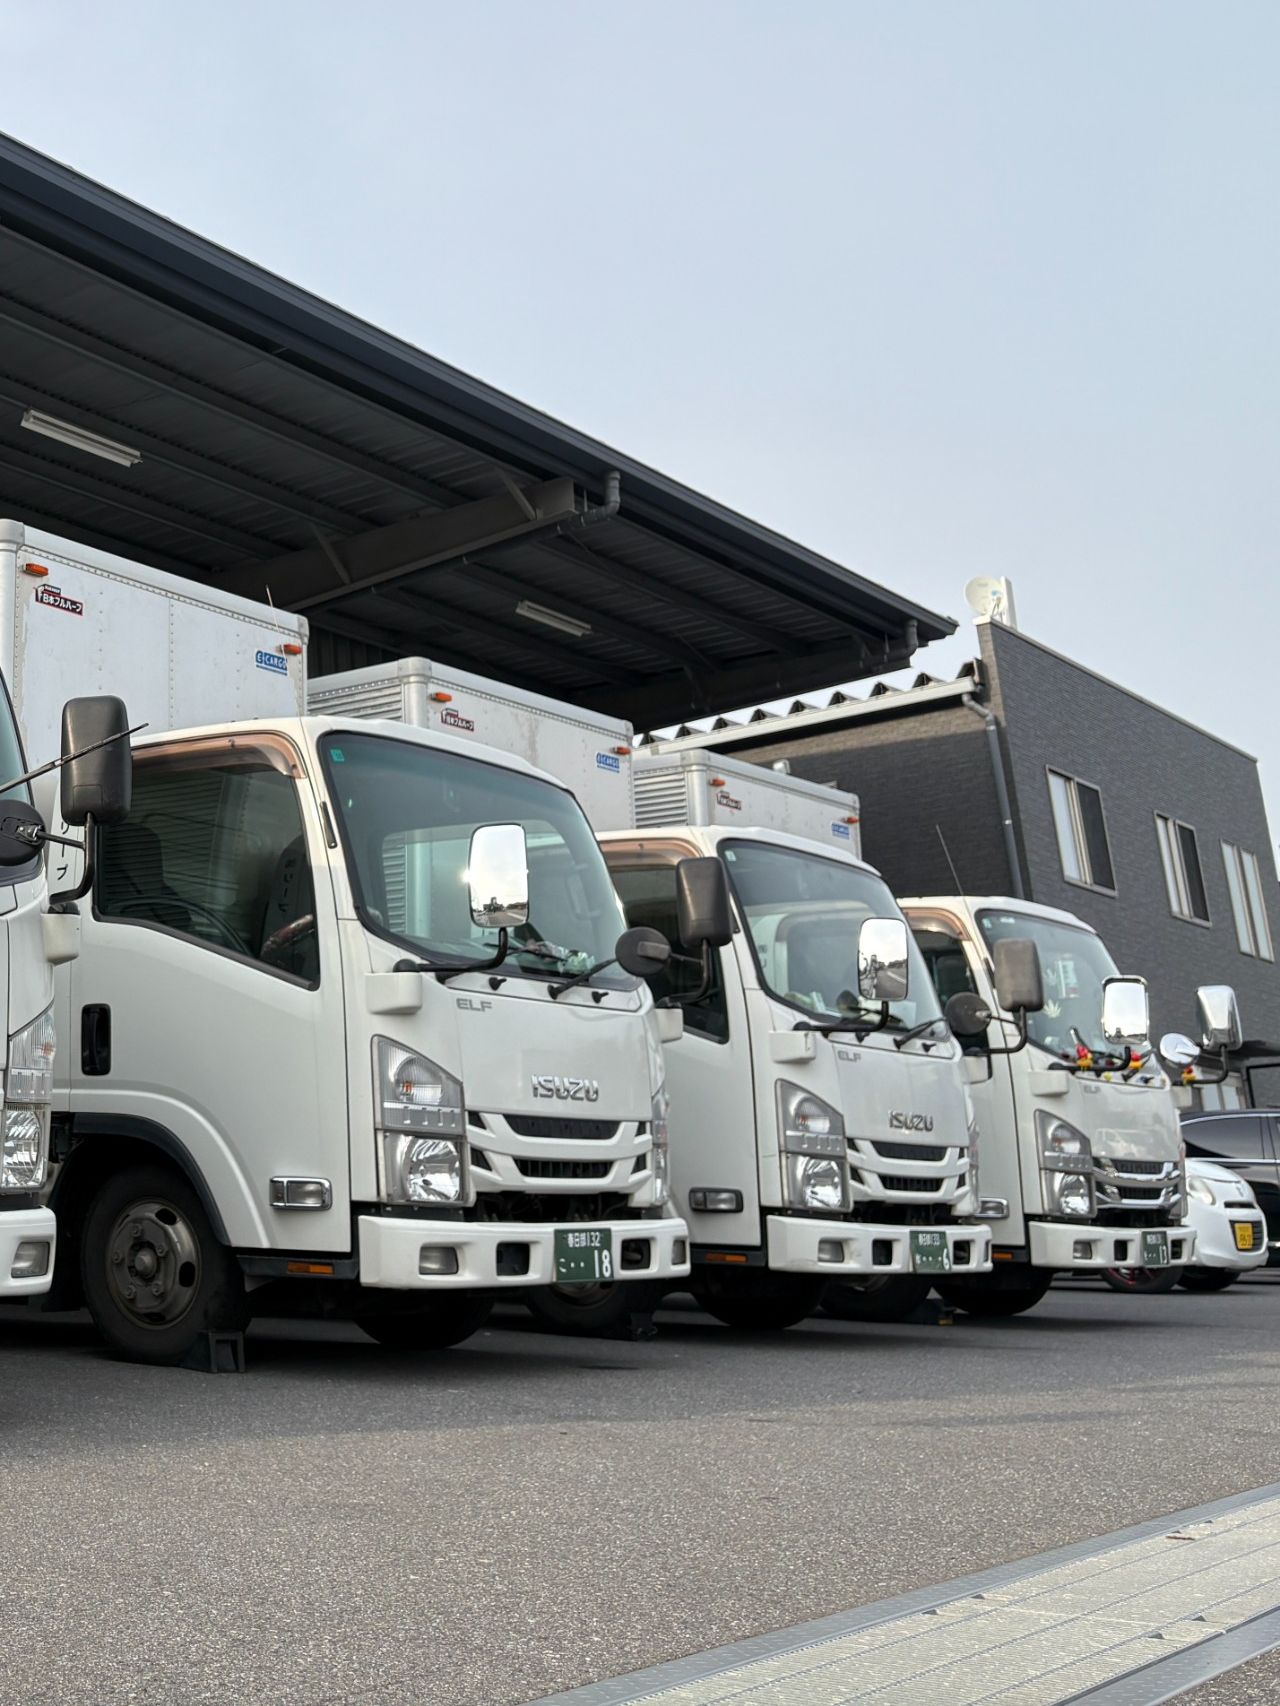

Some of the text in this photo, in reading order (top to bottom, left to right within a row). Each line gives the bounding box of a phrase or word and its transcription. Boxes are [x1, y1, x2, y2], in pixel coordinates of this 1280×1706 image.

[456, 998, 492, 1012] ELF
[531, 1074, 598, 1102] ISUZU
[888, 1110, 933, 1132] ISUZU
